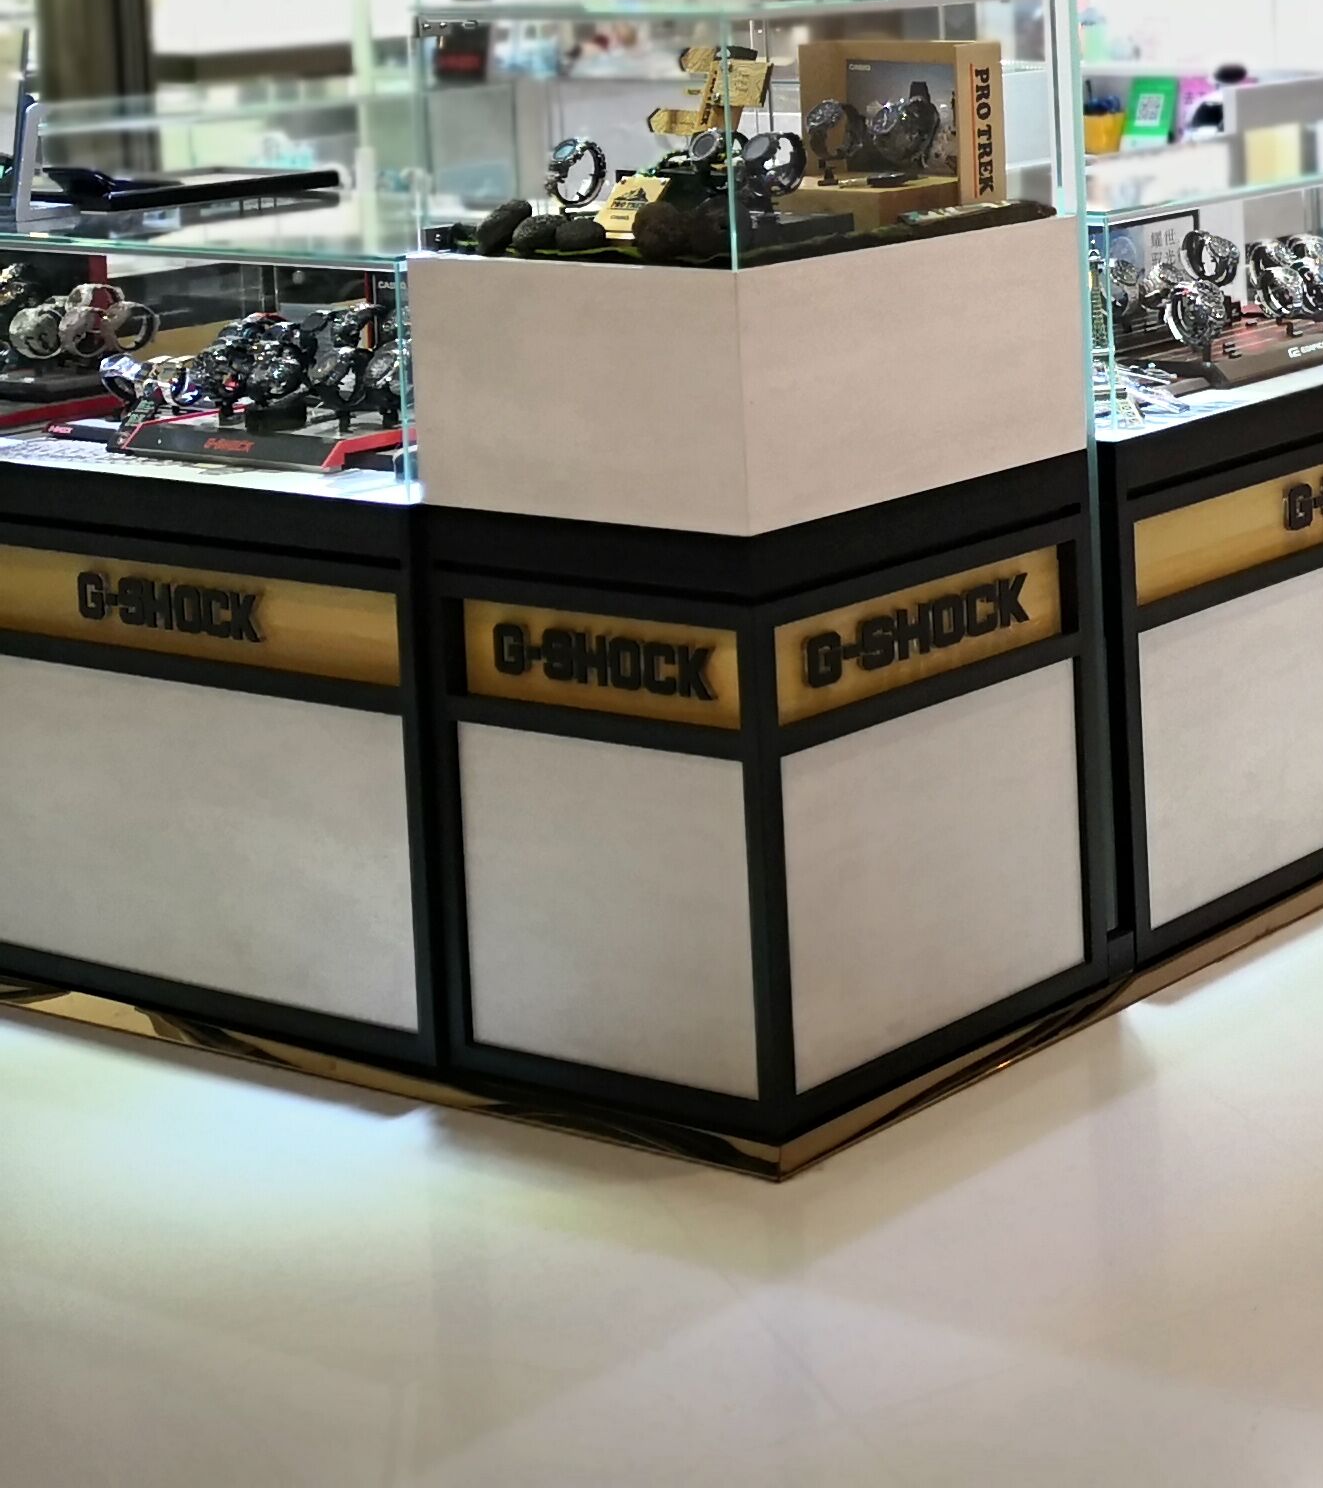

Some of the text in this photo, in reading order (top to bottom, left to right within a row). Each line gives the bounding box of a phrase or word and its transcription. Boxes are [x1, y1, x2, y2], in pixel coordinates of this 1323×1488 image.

[974, 67, 994, 196] PRO TREK
[378, 280, 407, 290] CASO
[77, 571, 263, 643] G-SHOCK
[803, 572, 1030, 689] G-SHOCK
[493, 622, 718, 701] G-SHOCK
